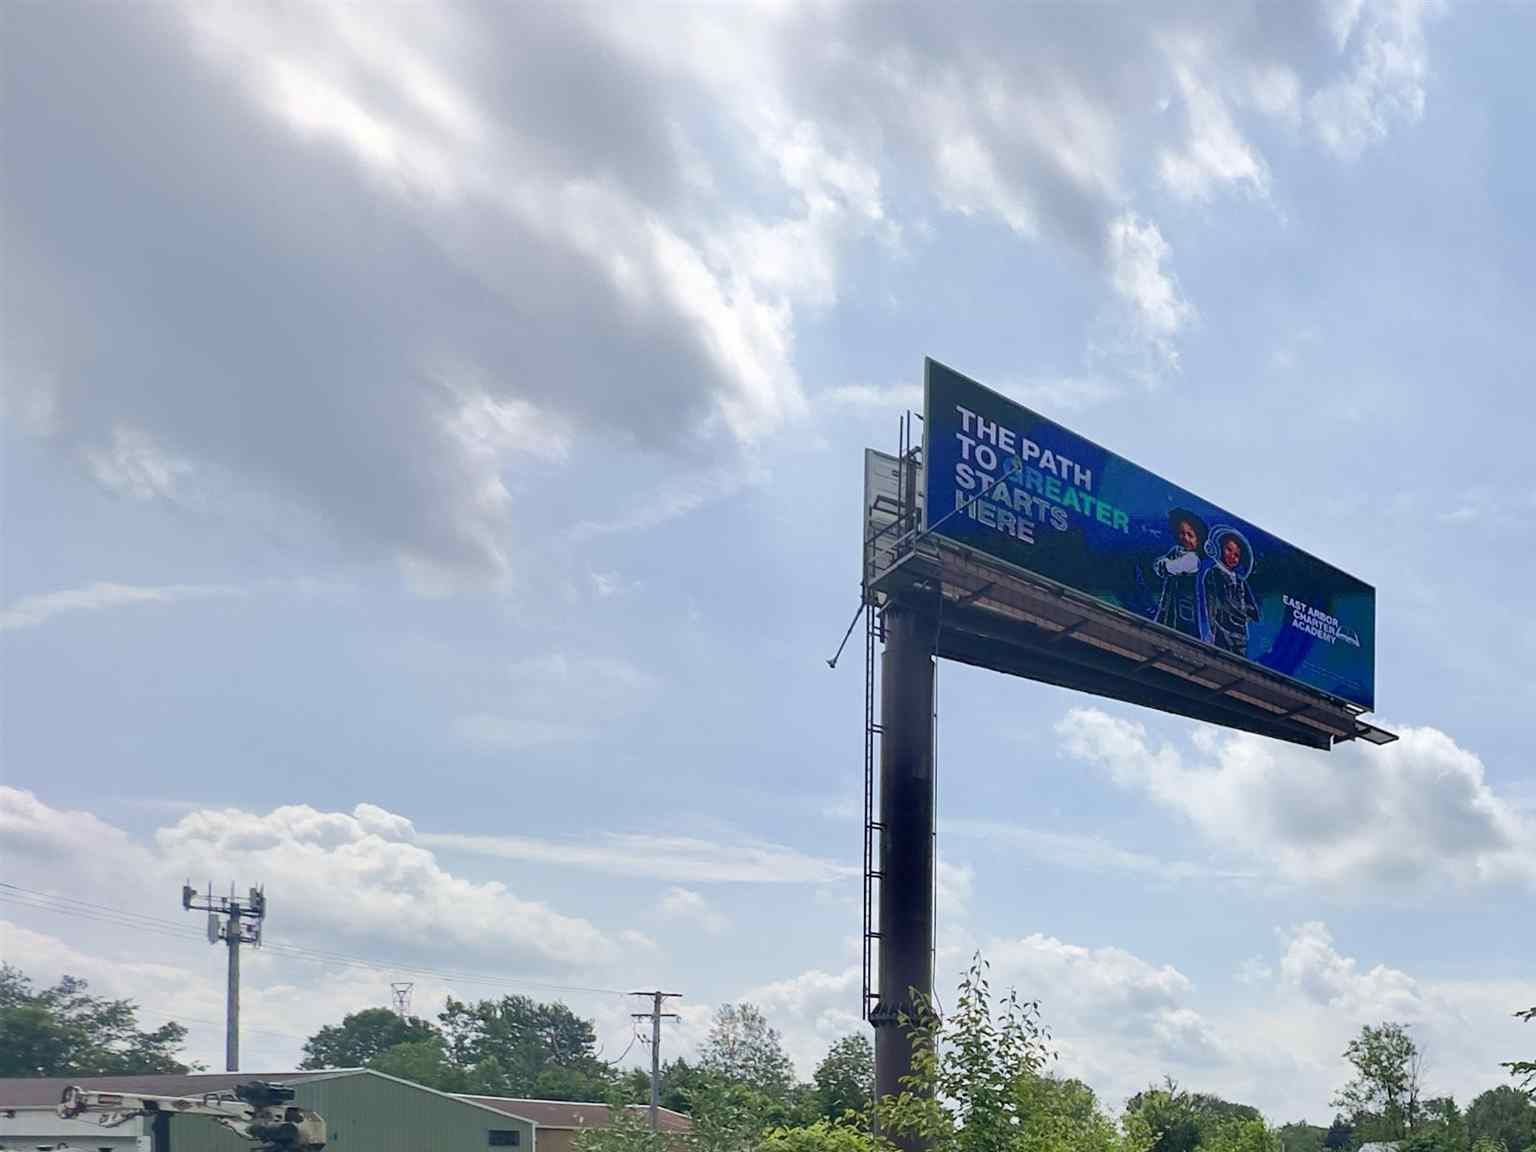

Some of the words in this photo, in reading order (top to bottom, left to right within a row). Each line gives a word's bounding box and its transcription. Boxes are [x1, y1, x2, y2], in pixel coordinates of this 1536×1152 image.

[956, 405, 1016, 454] THE
[1022, 438, 1092, 491] PATH
[956, 432, 997, 471] TO
[1003, 455, 1129, 533] GREATER
[955, 463, 1068, 532] STARTS
[955, 489, 1035, 545] HERE
[1282, 594, 1307, 612] EAST
